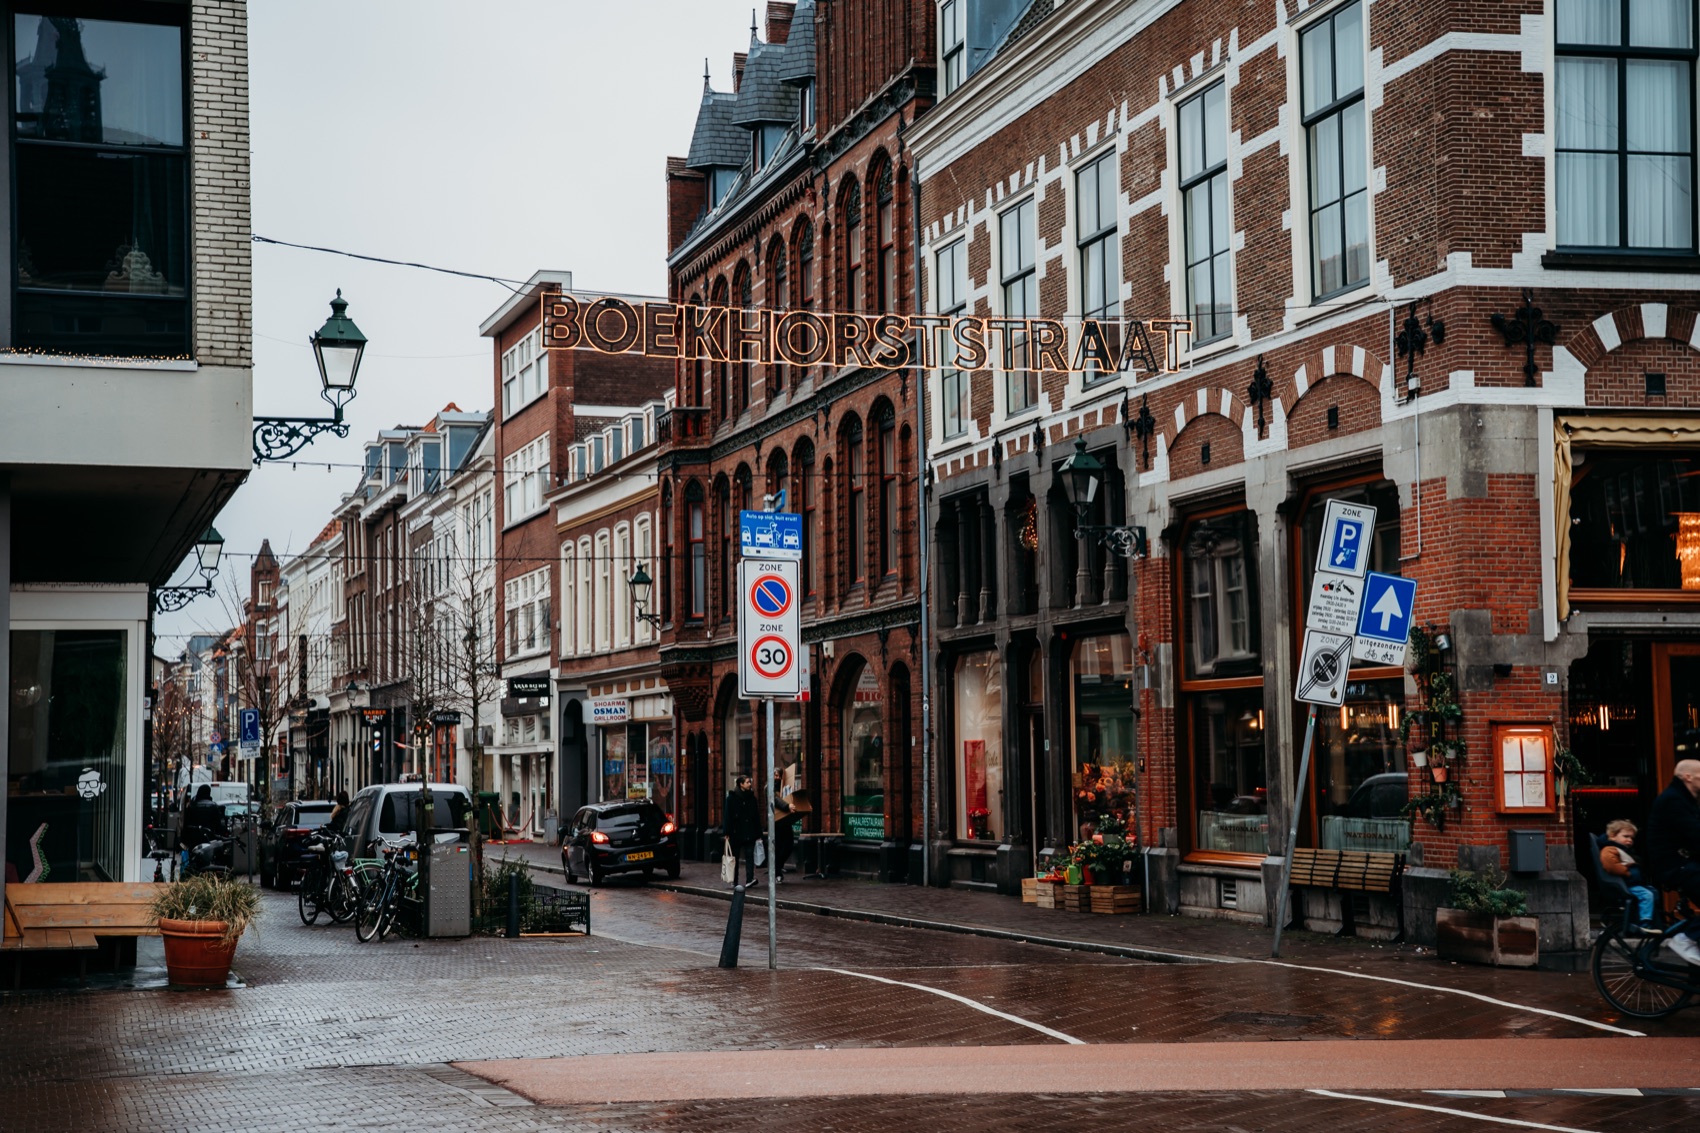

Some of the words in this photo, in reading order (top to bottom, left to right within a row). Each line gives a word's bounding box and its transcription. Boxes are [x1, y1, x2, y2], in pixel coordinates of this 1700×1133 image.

[540, 292, 1193, 373] BOEKHORSTSTRAAT
[1342, 507, 1362, 518] ZONE
[1339, 523, 1357, 548] P
[759, 563, 783, 572] ZONE
[759, 623, 783, 632] ZONE
[1320, 635, 1340, 646] ZONE
[1360, 638, 1404, 652] uitgezonderd
[759, 648, 786, 665] 30
[1550, 674, 1555, 683] 2
[593, 707, 626, 715] OSMAN
[245, 712, 255, 729] P
